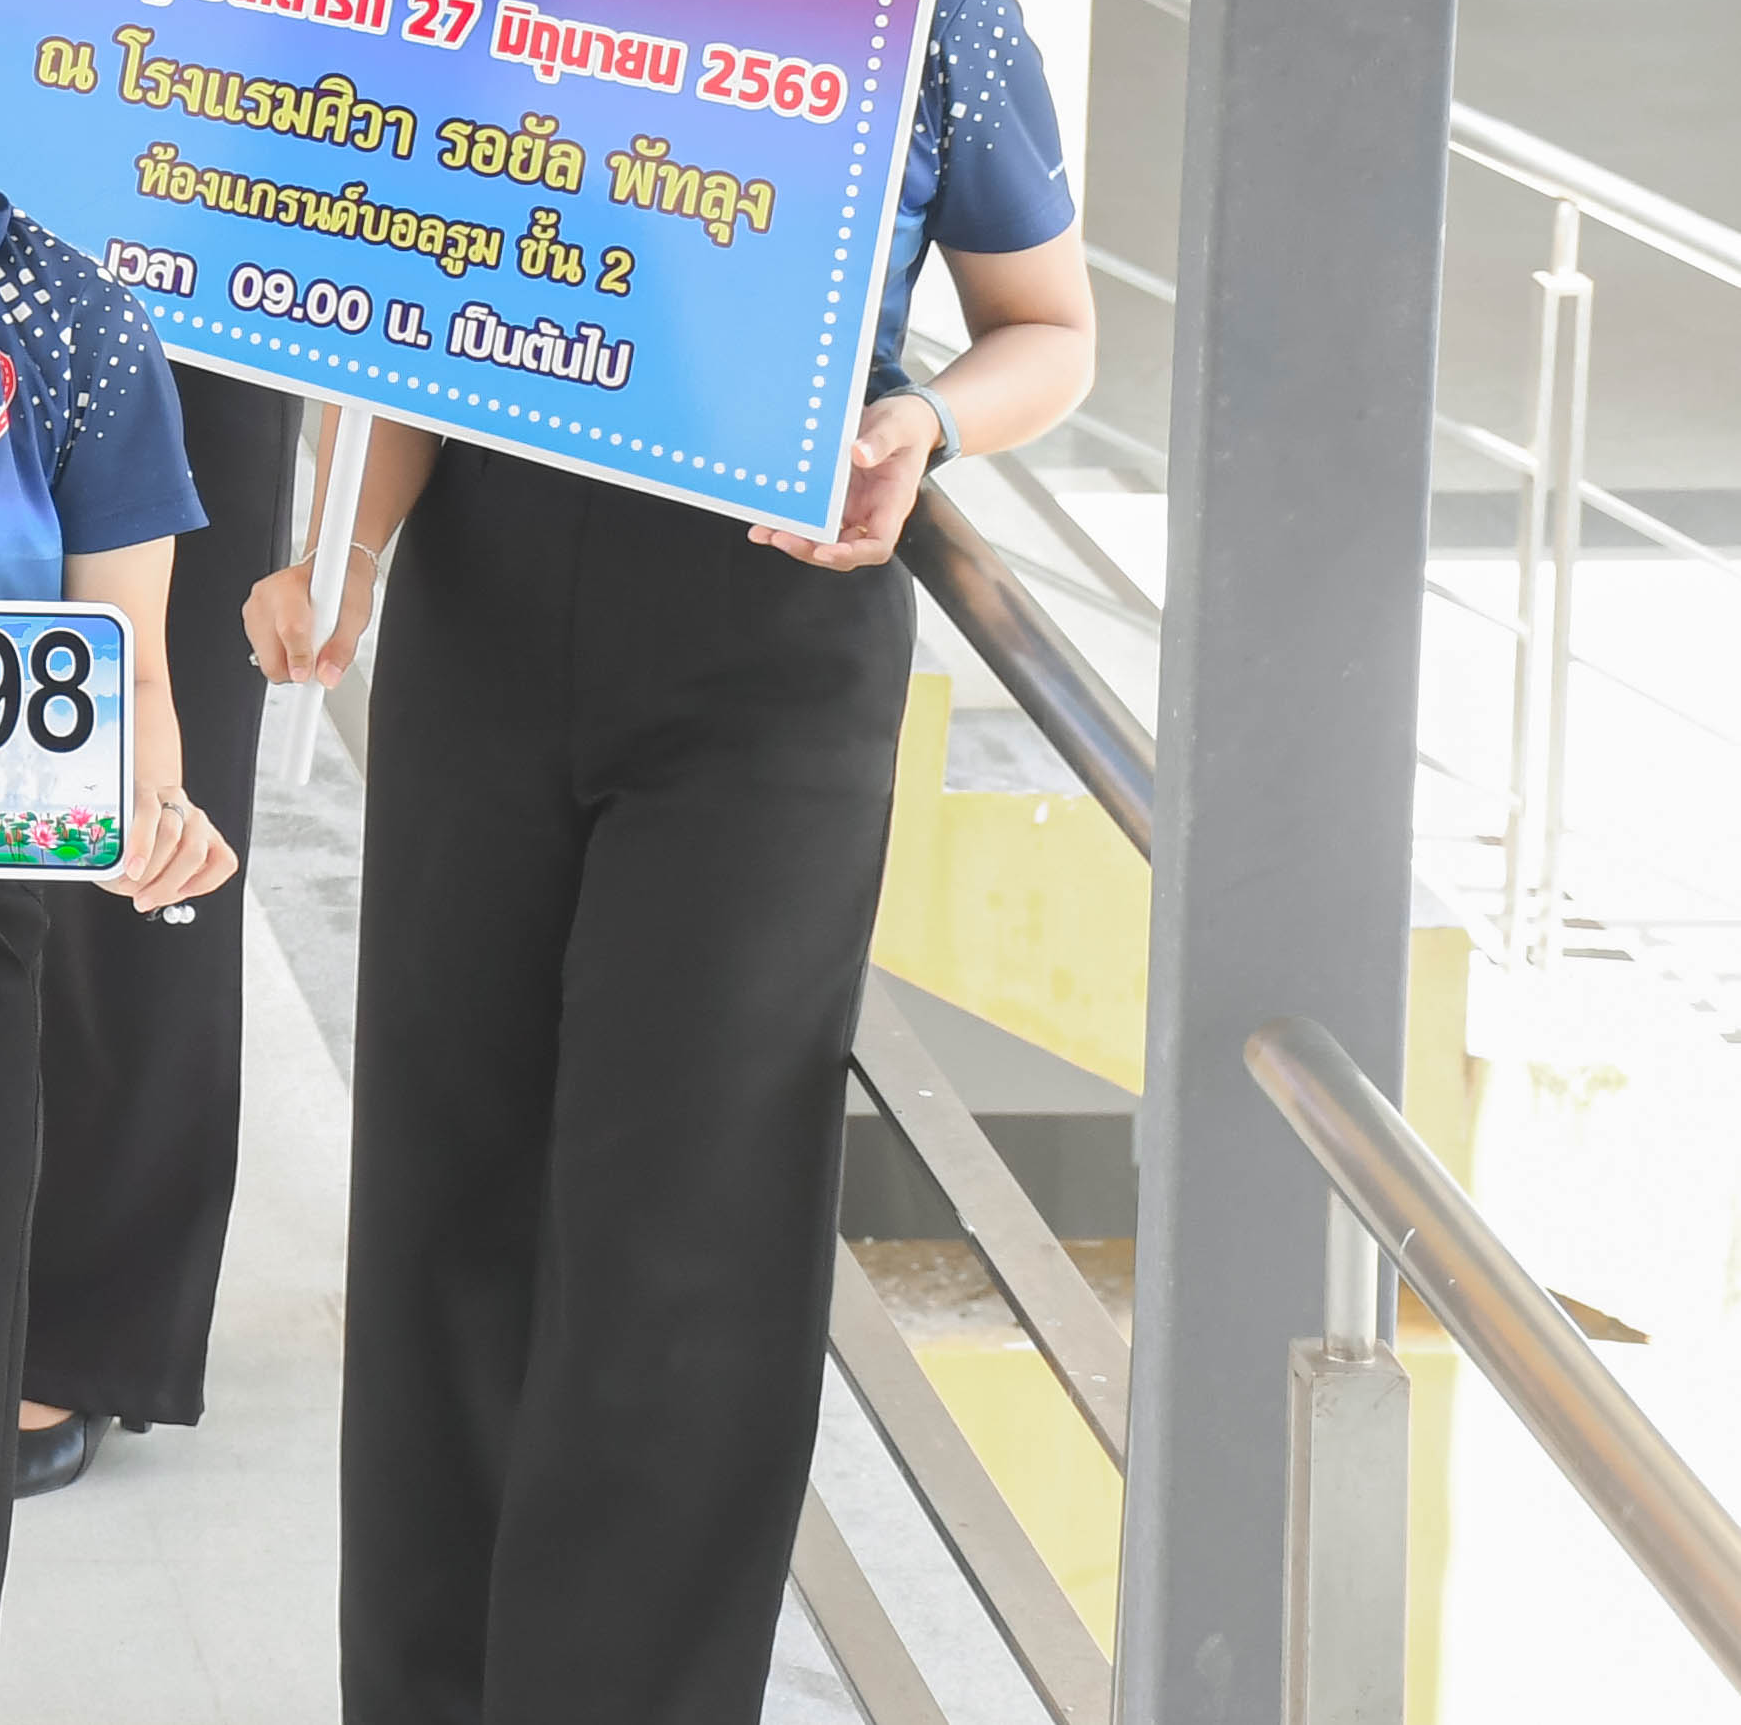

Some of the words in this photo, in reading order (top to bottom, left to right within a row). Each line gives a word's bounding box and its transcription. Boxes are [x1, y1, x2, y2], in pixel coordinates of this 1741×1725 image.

[37, 37, 95, 92] ณ
[115, 26, 415, 158] โรงแรมศิวา
[439, 112, 584, 192] รอยัล
[608, 136, 774, 245] พัทลุง
[498, 5, 681, 86] มิถุนายน
[702, 50, 841, 116] 2569
[136, 142, 502, 276] ห้องแกรนด์บอลรูม
[518, 208, 583, 284] ชั้น
[599, 249, 633, 295] 2
[107, 241, 195, 296] เวลา
[232, 266, 370, 332] 09.00
[388, 302, 430, 347] น.
[448, 306, 633, 388] เป็นต้นไป
